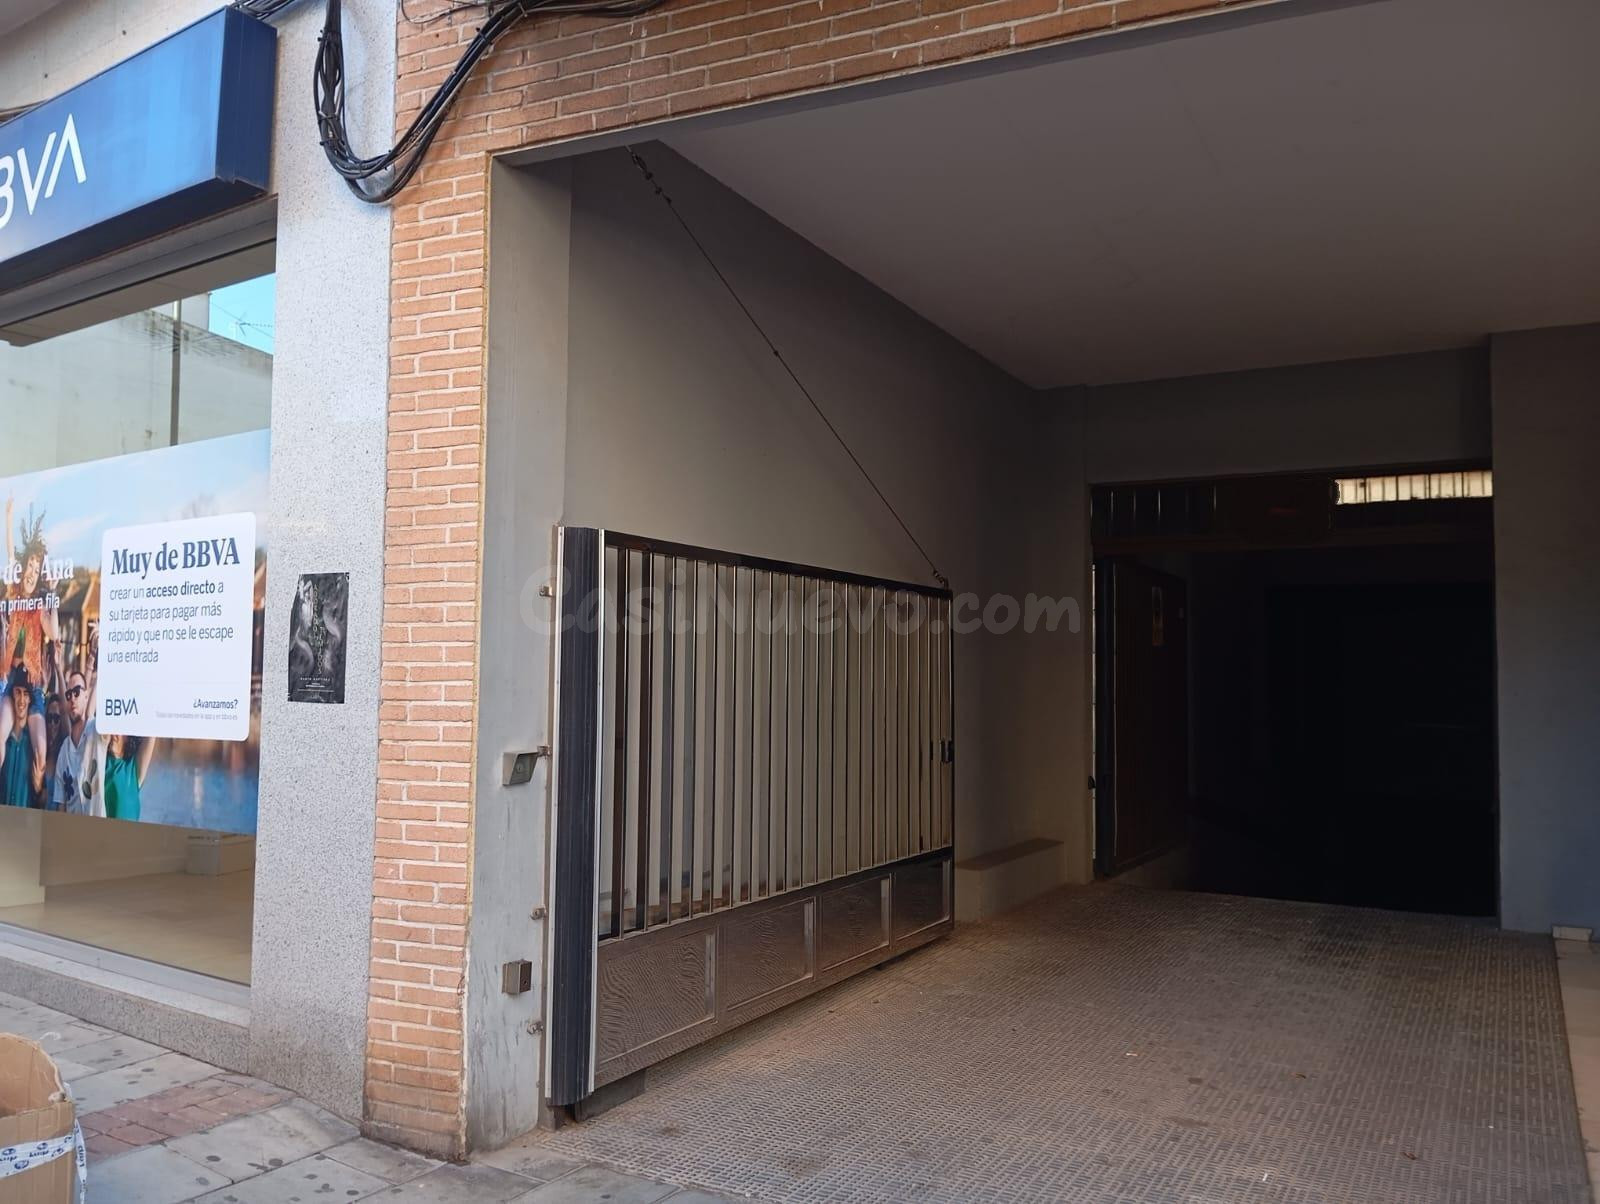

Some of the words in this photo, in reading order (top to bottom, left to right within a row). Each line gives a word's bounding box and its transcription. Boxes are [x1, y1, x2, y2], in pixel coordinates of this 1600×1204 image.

[110, 548, 152, 580] Muy
[155, 541, 179, 571] de
[182, 537, 241, 569] BBVA
[3, 559, 23, 585] de
[109, 587, 131, 600] crear
[133, 587, 145, 599] un
[145, 584, 179, 598] acceso
[180, 580, 216, 596] directo
[217, 582, 224, 593] a
[8, 595, 43, 616] primera
[45, 592, 60, 609] fila
[109, 609, 120, 622] su
[120, 606, 149, 623] tarjeta
[150, 608, 171, 622] para
[172, 606, 199, 622] pagar
[200, 601, 222, 617] más
[108, 628, 136, 645] rápido
[143, 629, 161, 644] que
[162, 628, 174, 640] no
[175, 628, 187, 640] se
[188, 625, 197, 640] le
[198, 626, 234, 642] escape
[107, 650, 123, 663] una
[124, 648, 159, 663] entrada
[105, 698, 139, 716] BBVA
[193, 698, 238, 709] ¿Avanzamos?
